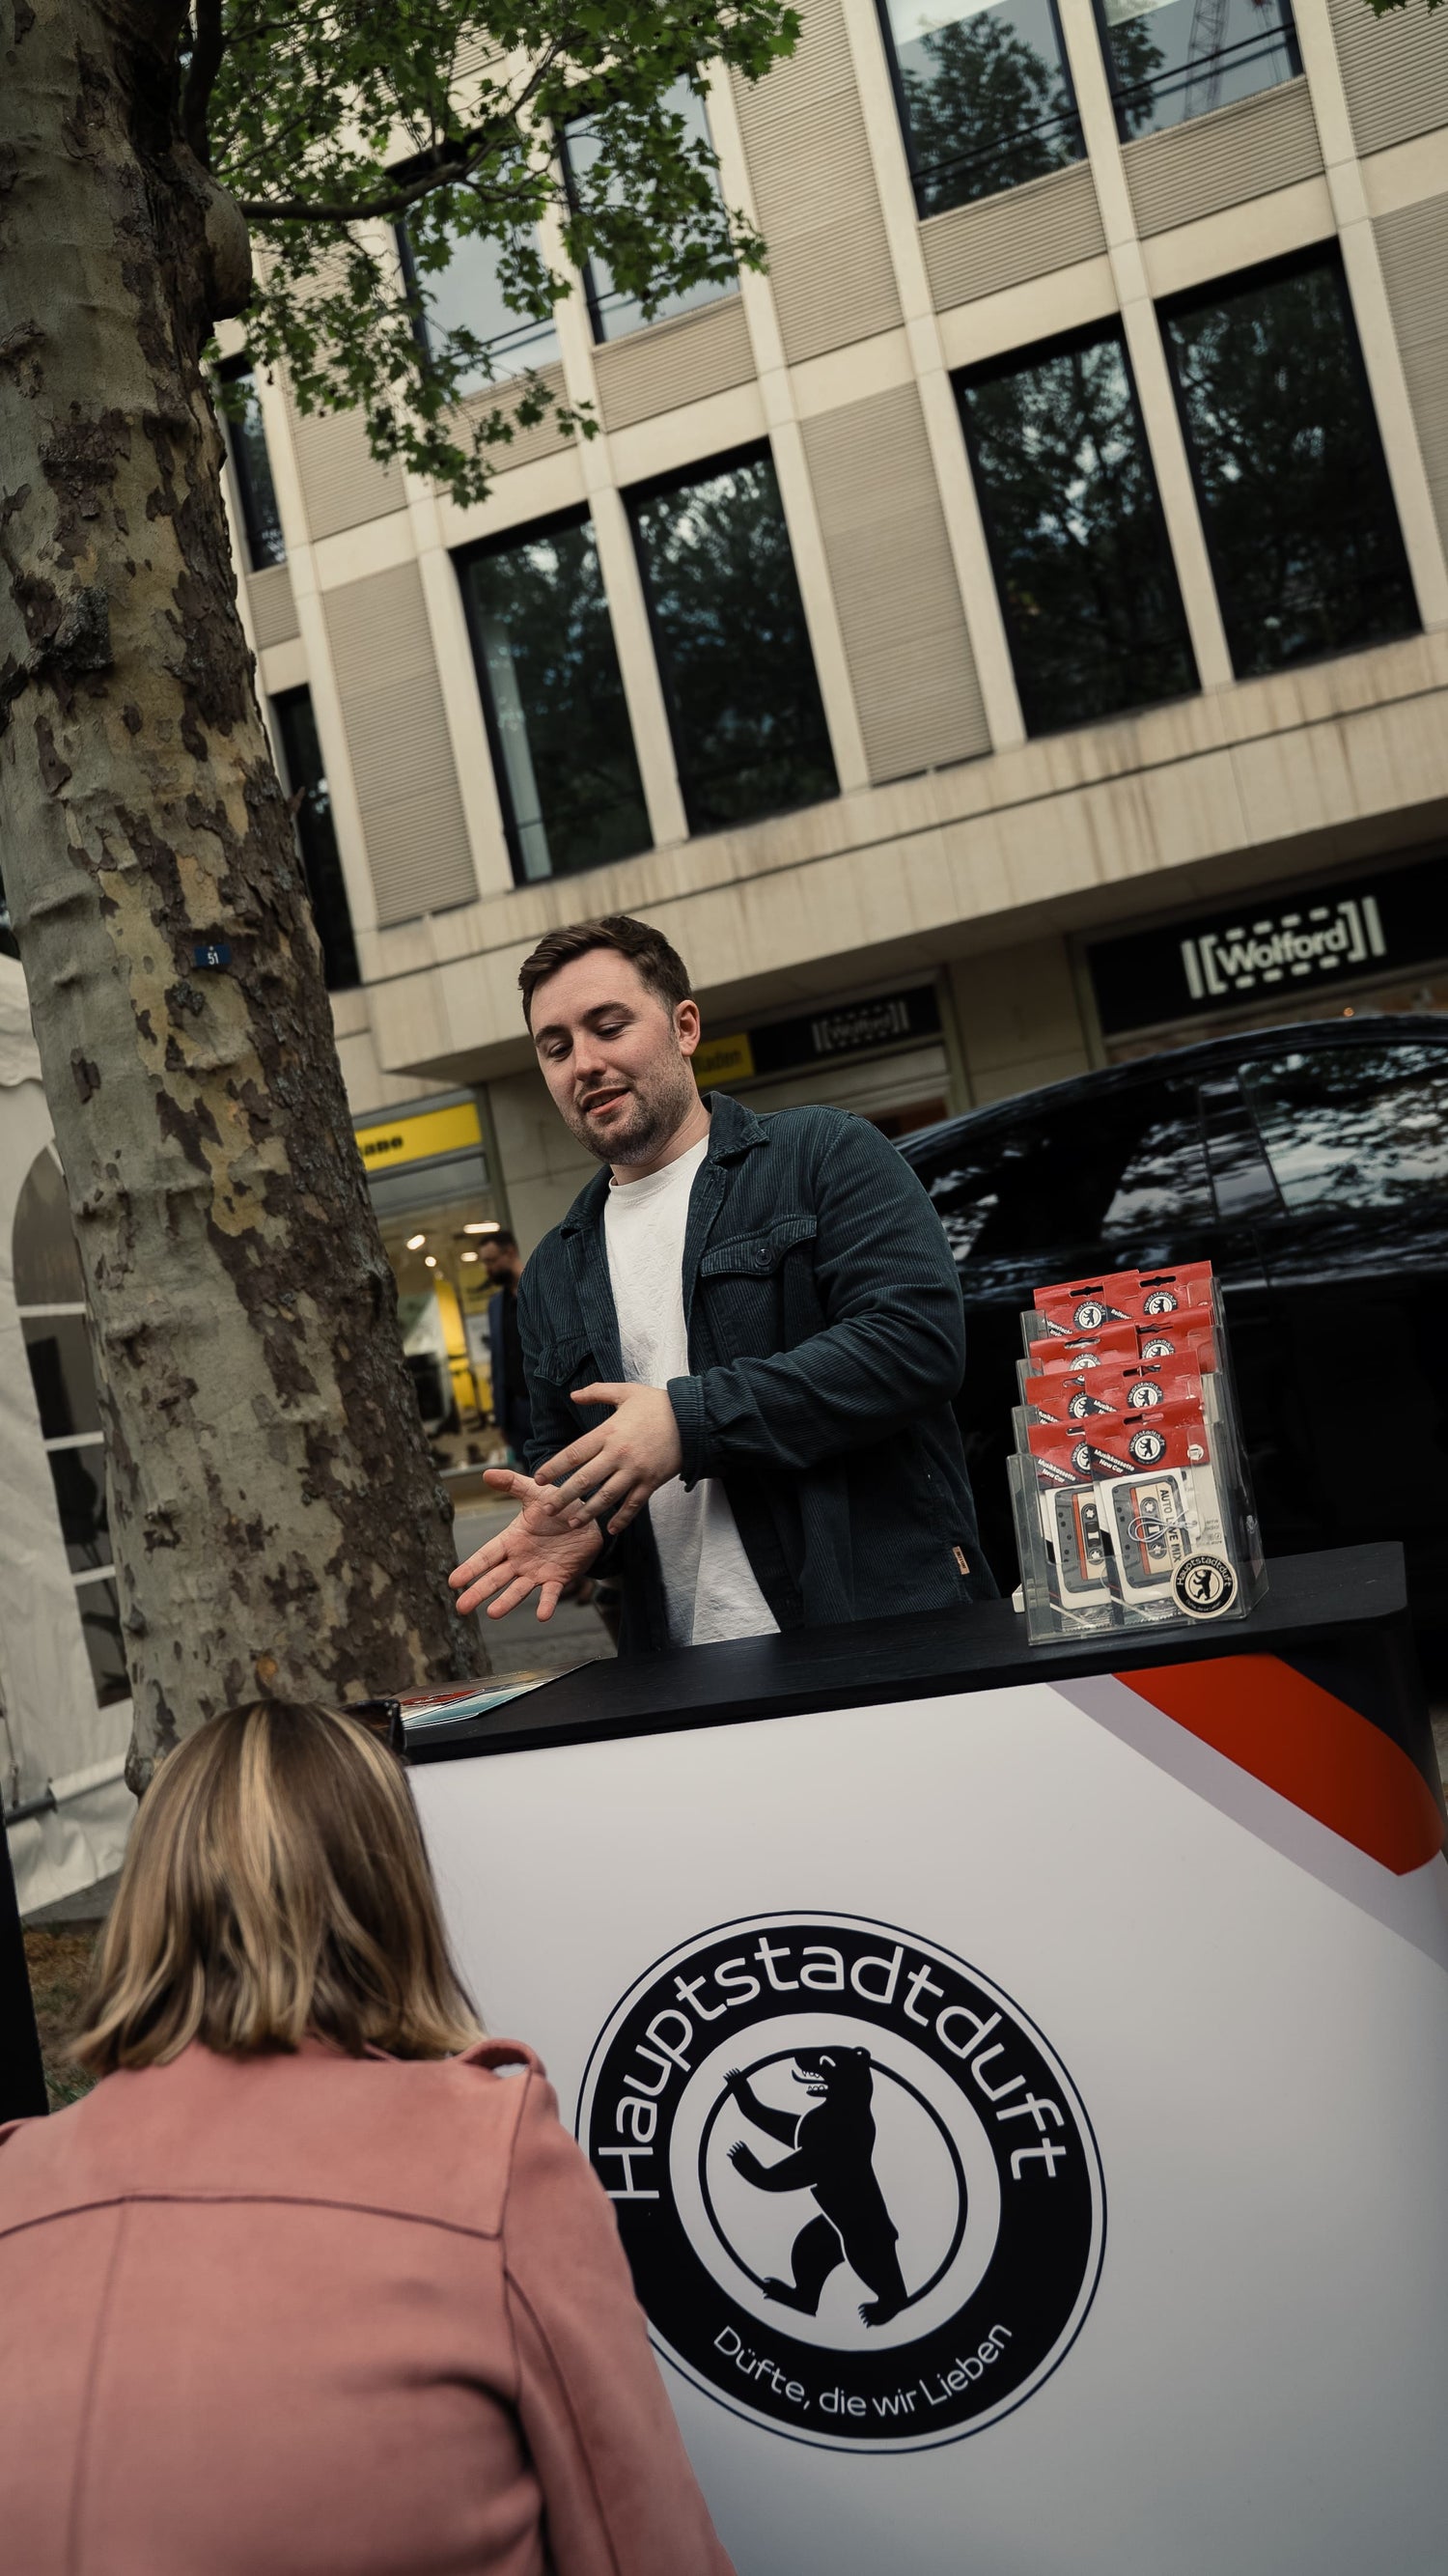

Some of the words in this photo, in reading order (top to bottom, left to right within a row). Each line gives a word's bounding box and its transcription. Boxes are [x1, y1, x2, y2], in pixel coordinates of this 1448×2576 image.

[1216, 918, 1349, 976] Wolford
[207, 952, 219, 966] 51
[1038, 1458, 1076, 1481] Musikkassette
[1094, 1448, 1134, 1471] Musikkassette
[1100, 1458, 1113, 1470] New
[1112, 1465, 1124, 1473] Car
[1042, 1468, 1055, 1479] New
[1054, 1474, 1065, 1483] Car
[1159, 1489, 1173, 1514] AUTO
[1165, 1517, 1179, 1541] LVE
[1171, 1543, 1183, 1563] MIX
[1176, 1556, 1233, 1586] Hauptstadtduft
[598, 1937, 1067, 2199] Hauptstadtduft
[712, 2325, 812, 2410] Düfte,
[819, 2387, 868, 2417] die
[871, 2390, 918, 2417] wir
[918, 2323, 1014, 2406] Lieben
